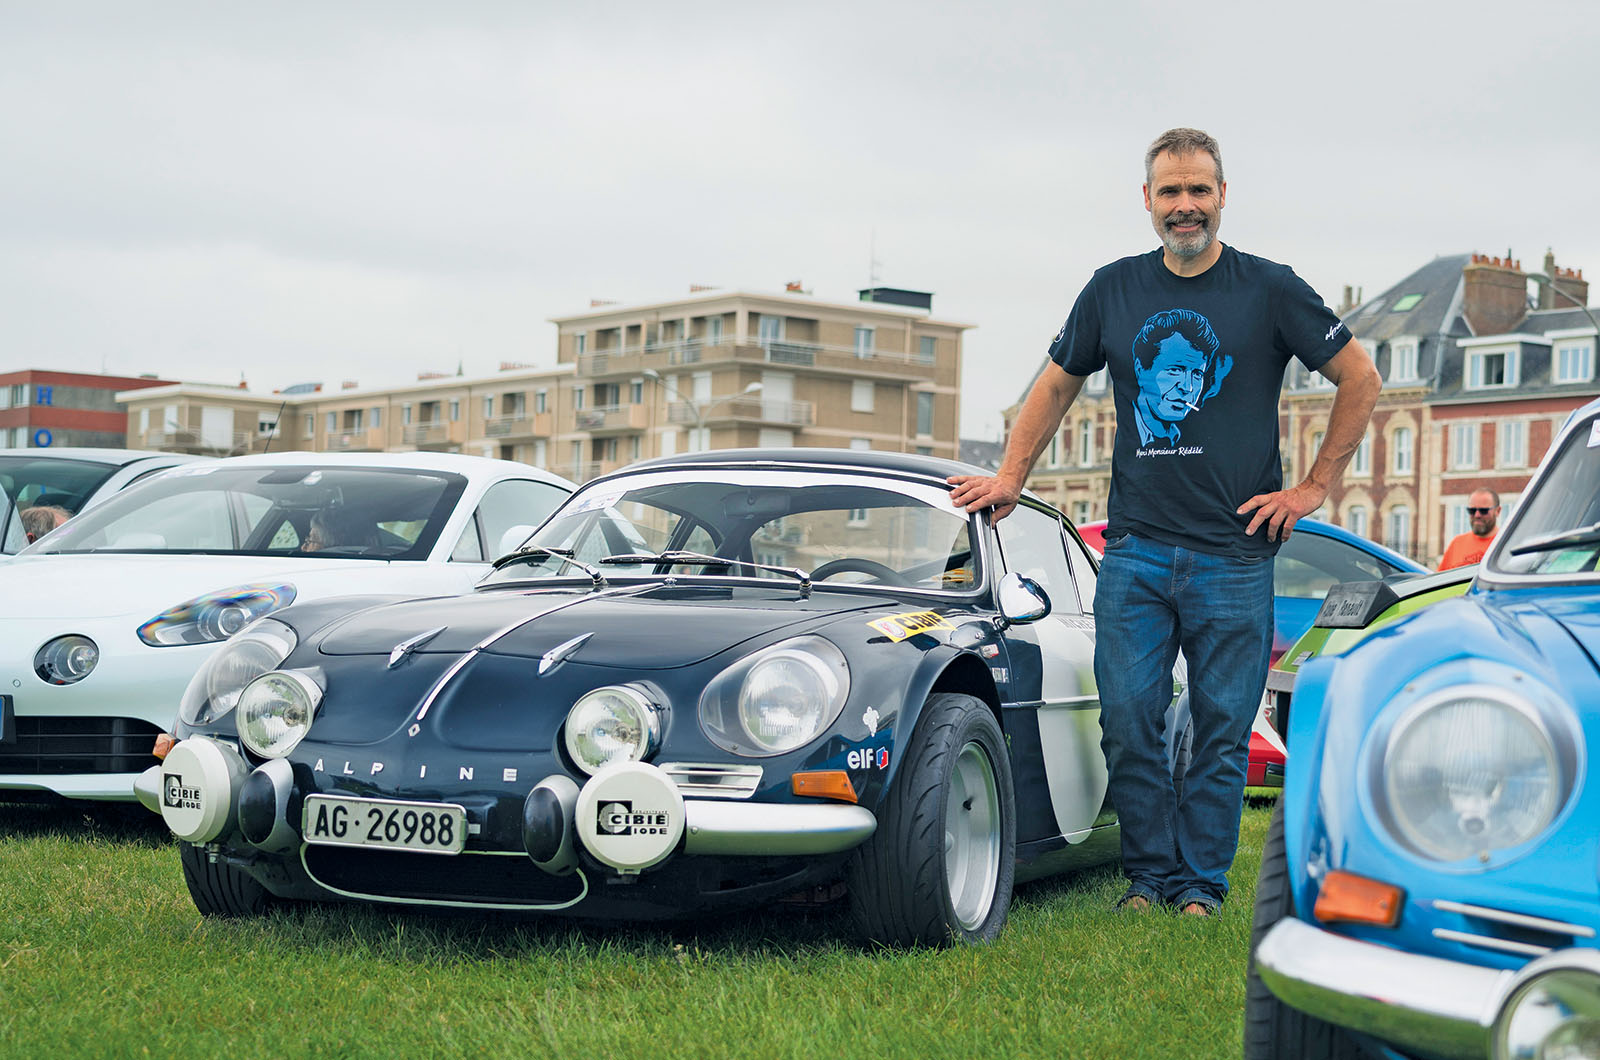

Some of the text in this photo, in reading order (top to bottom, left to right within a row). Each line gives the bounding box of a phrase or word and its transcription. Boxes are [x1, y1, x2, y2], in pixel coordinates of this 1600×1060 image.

[1148, 447, 1177, 458] Monsieur
[847, 748, 874, 770] elf
[314, 758, 518, 782] ALPINE
[170, 788, 200, 800] CIBIE
[367, 808, 454, 846] 26988
[610, 814, 666, 825] CIBIE
